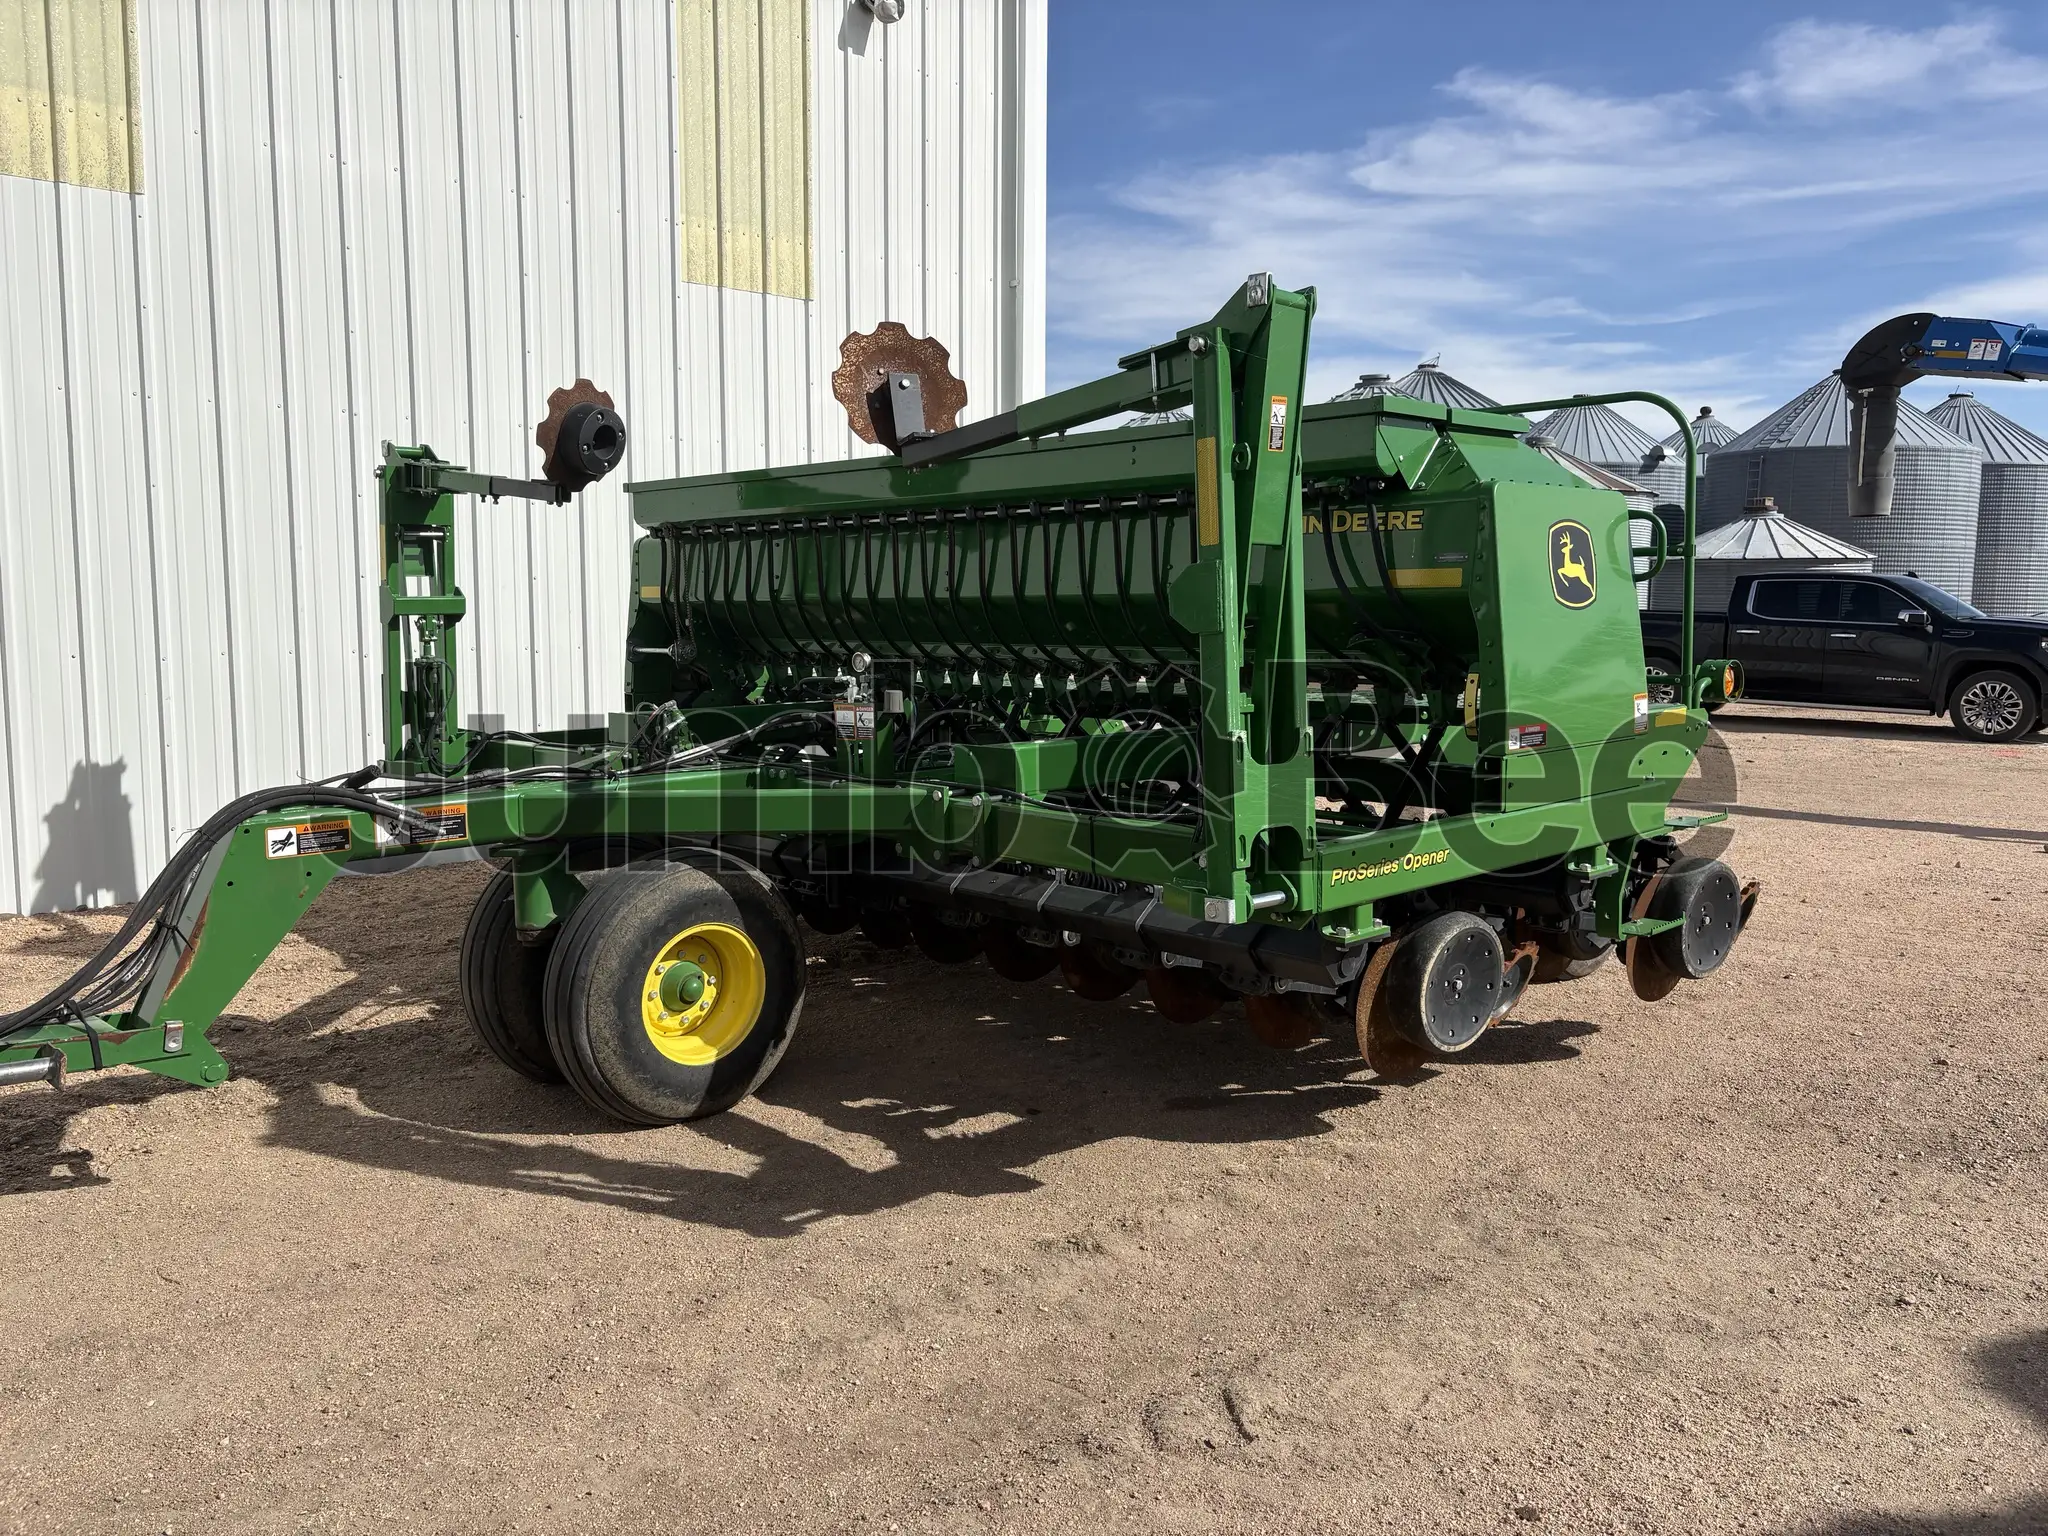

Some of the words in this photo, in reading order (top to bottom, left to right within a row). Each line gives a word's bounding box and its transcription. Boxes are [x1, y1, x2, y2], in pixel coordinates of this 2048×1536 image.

[425, 808, 461, 816] WARNING
[310, 822, 344, 831] WARNING
[1403, 849, 1450, 872] Opener
